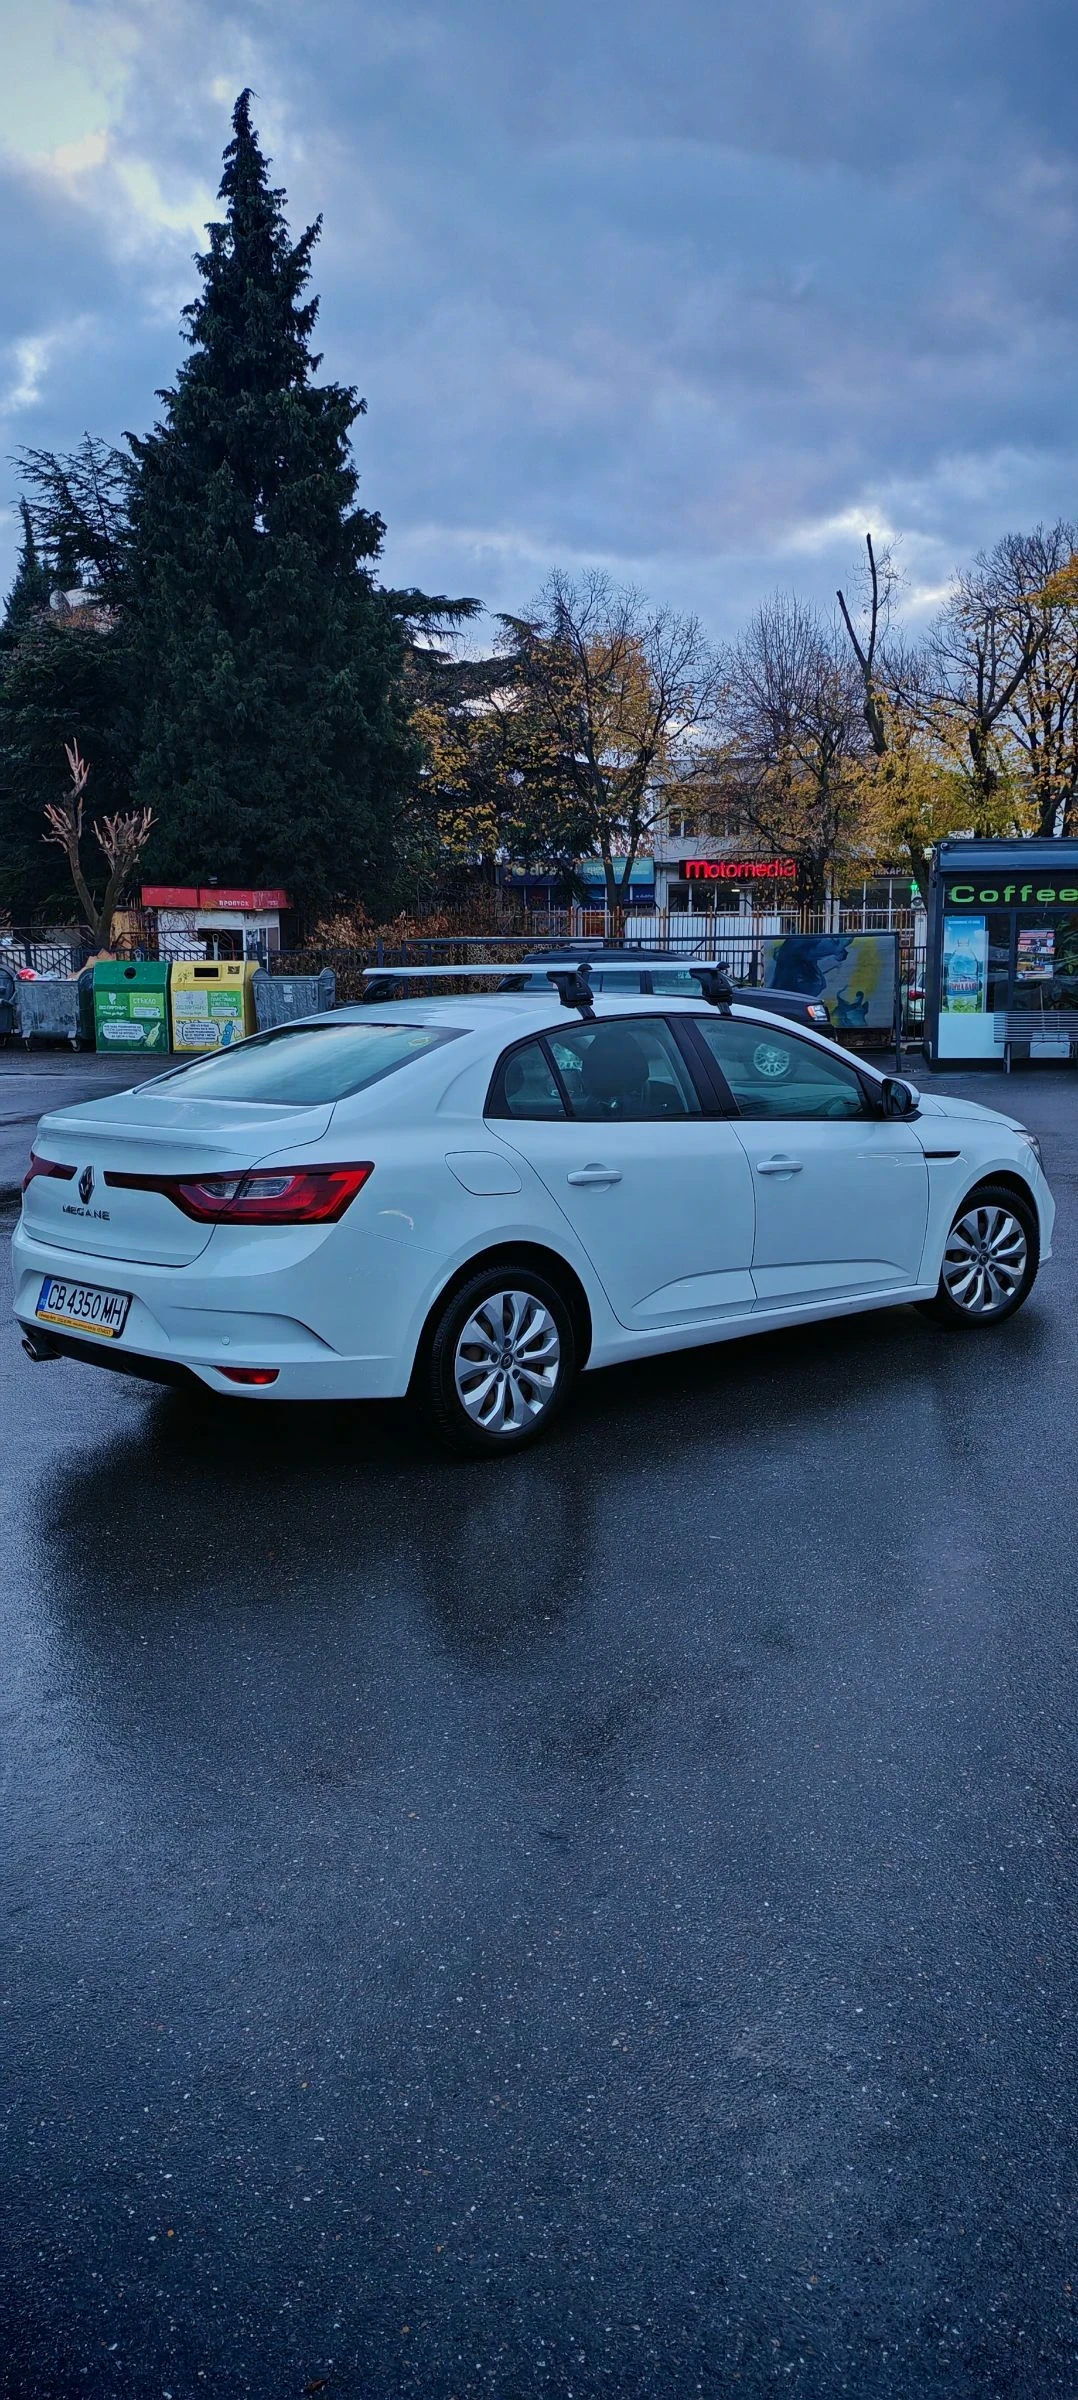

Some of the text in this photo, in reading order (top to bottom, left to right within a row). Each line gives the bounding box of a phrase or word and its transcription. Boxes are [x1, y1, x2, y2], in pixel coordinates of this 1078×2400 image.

[951, 885, 1078, 902] Coffee
[62, 1205, 110, 1221] MEGANE
[67, 1289, 102, 1319] 4350
